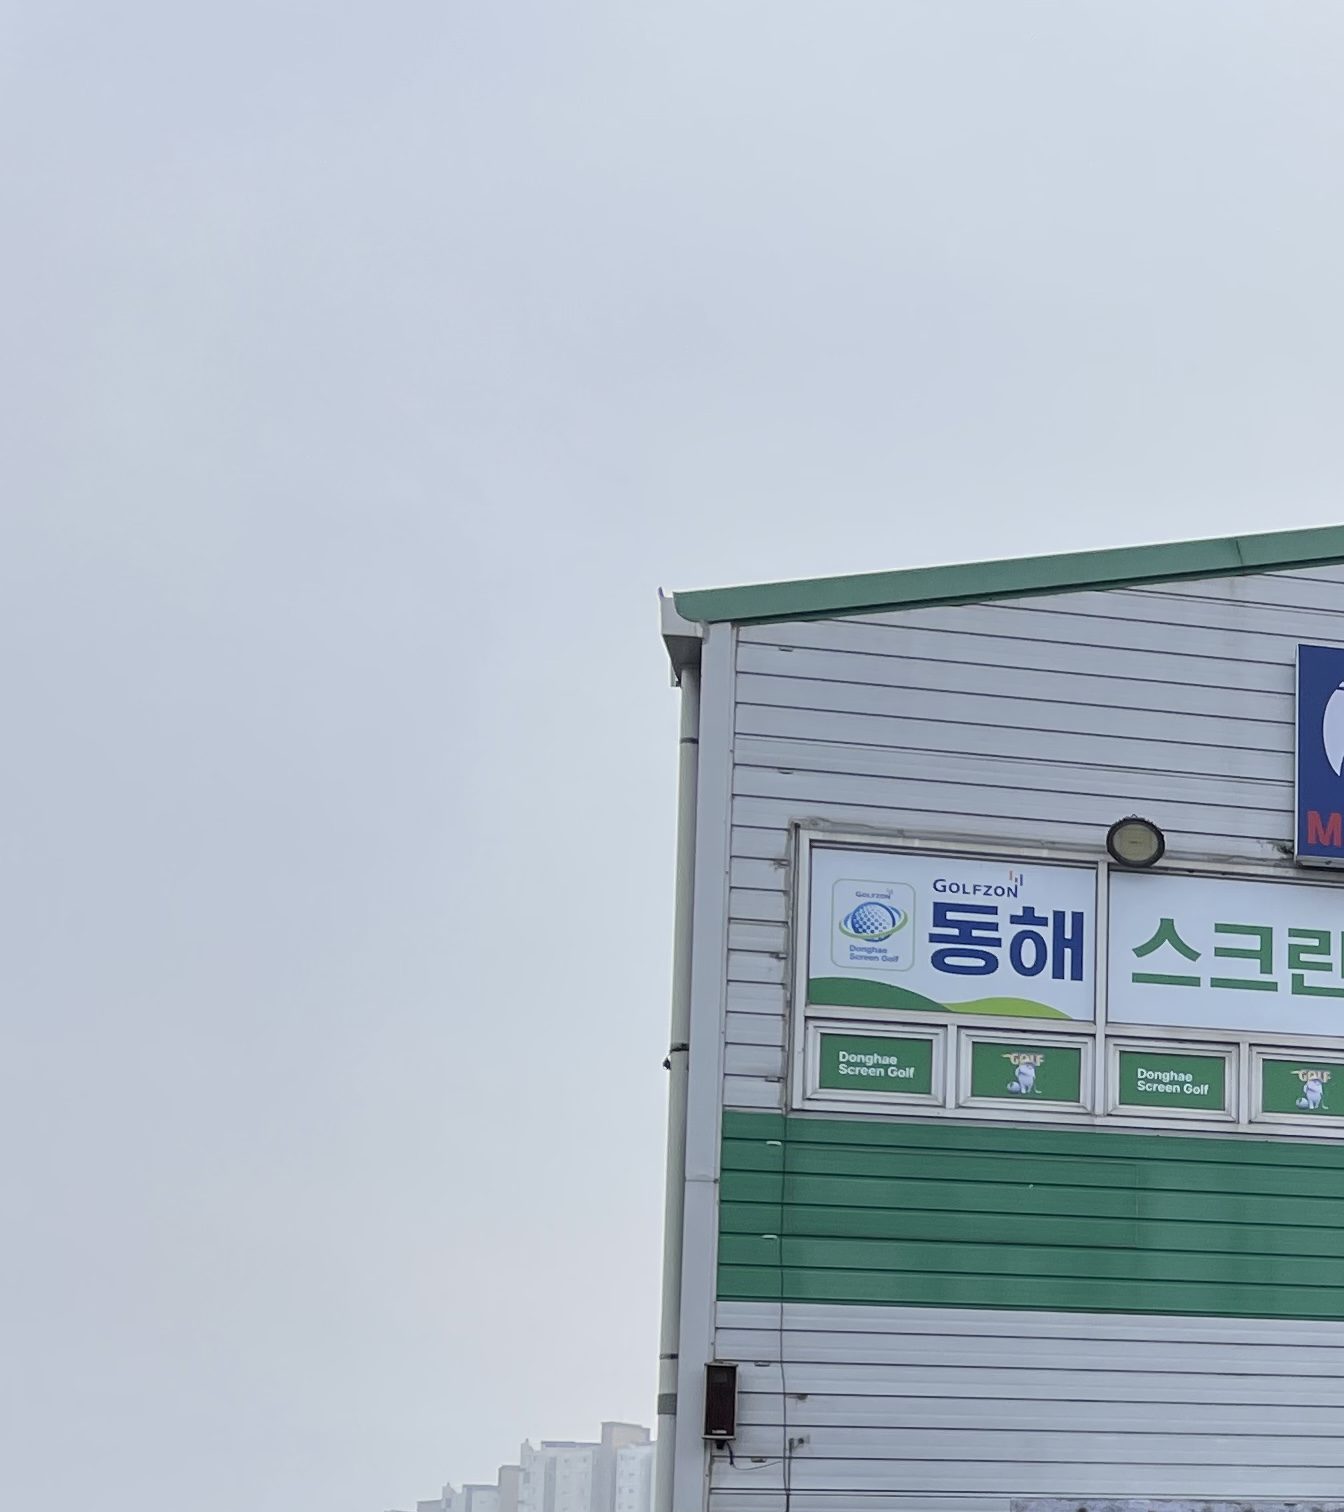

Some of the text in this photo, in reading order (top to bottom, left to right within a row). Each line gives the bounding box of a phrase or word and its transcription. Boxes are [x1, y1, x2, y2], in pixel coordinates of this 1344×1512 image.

[932, 878, 1019, 898] GOLFZON
[928, 901, 1085, 982] 동해
[838, 1051, 898, 1066] Donghae
[838, 1063, 915, 1079] Screen Golf
[1137, 1068, 1193, 1083] Donghae
[1137, 1080, 1209, 1096] Screen Golf
